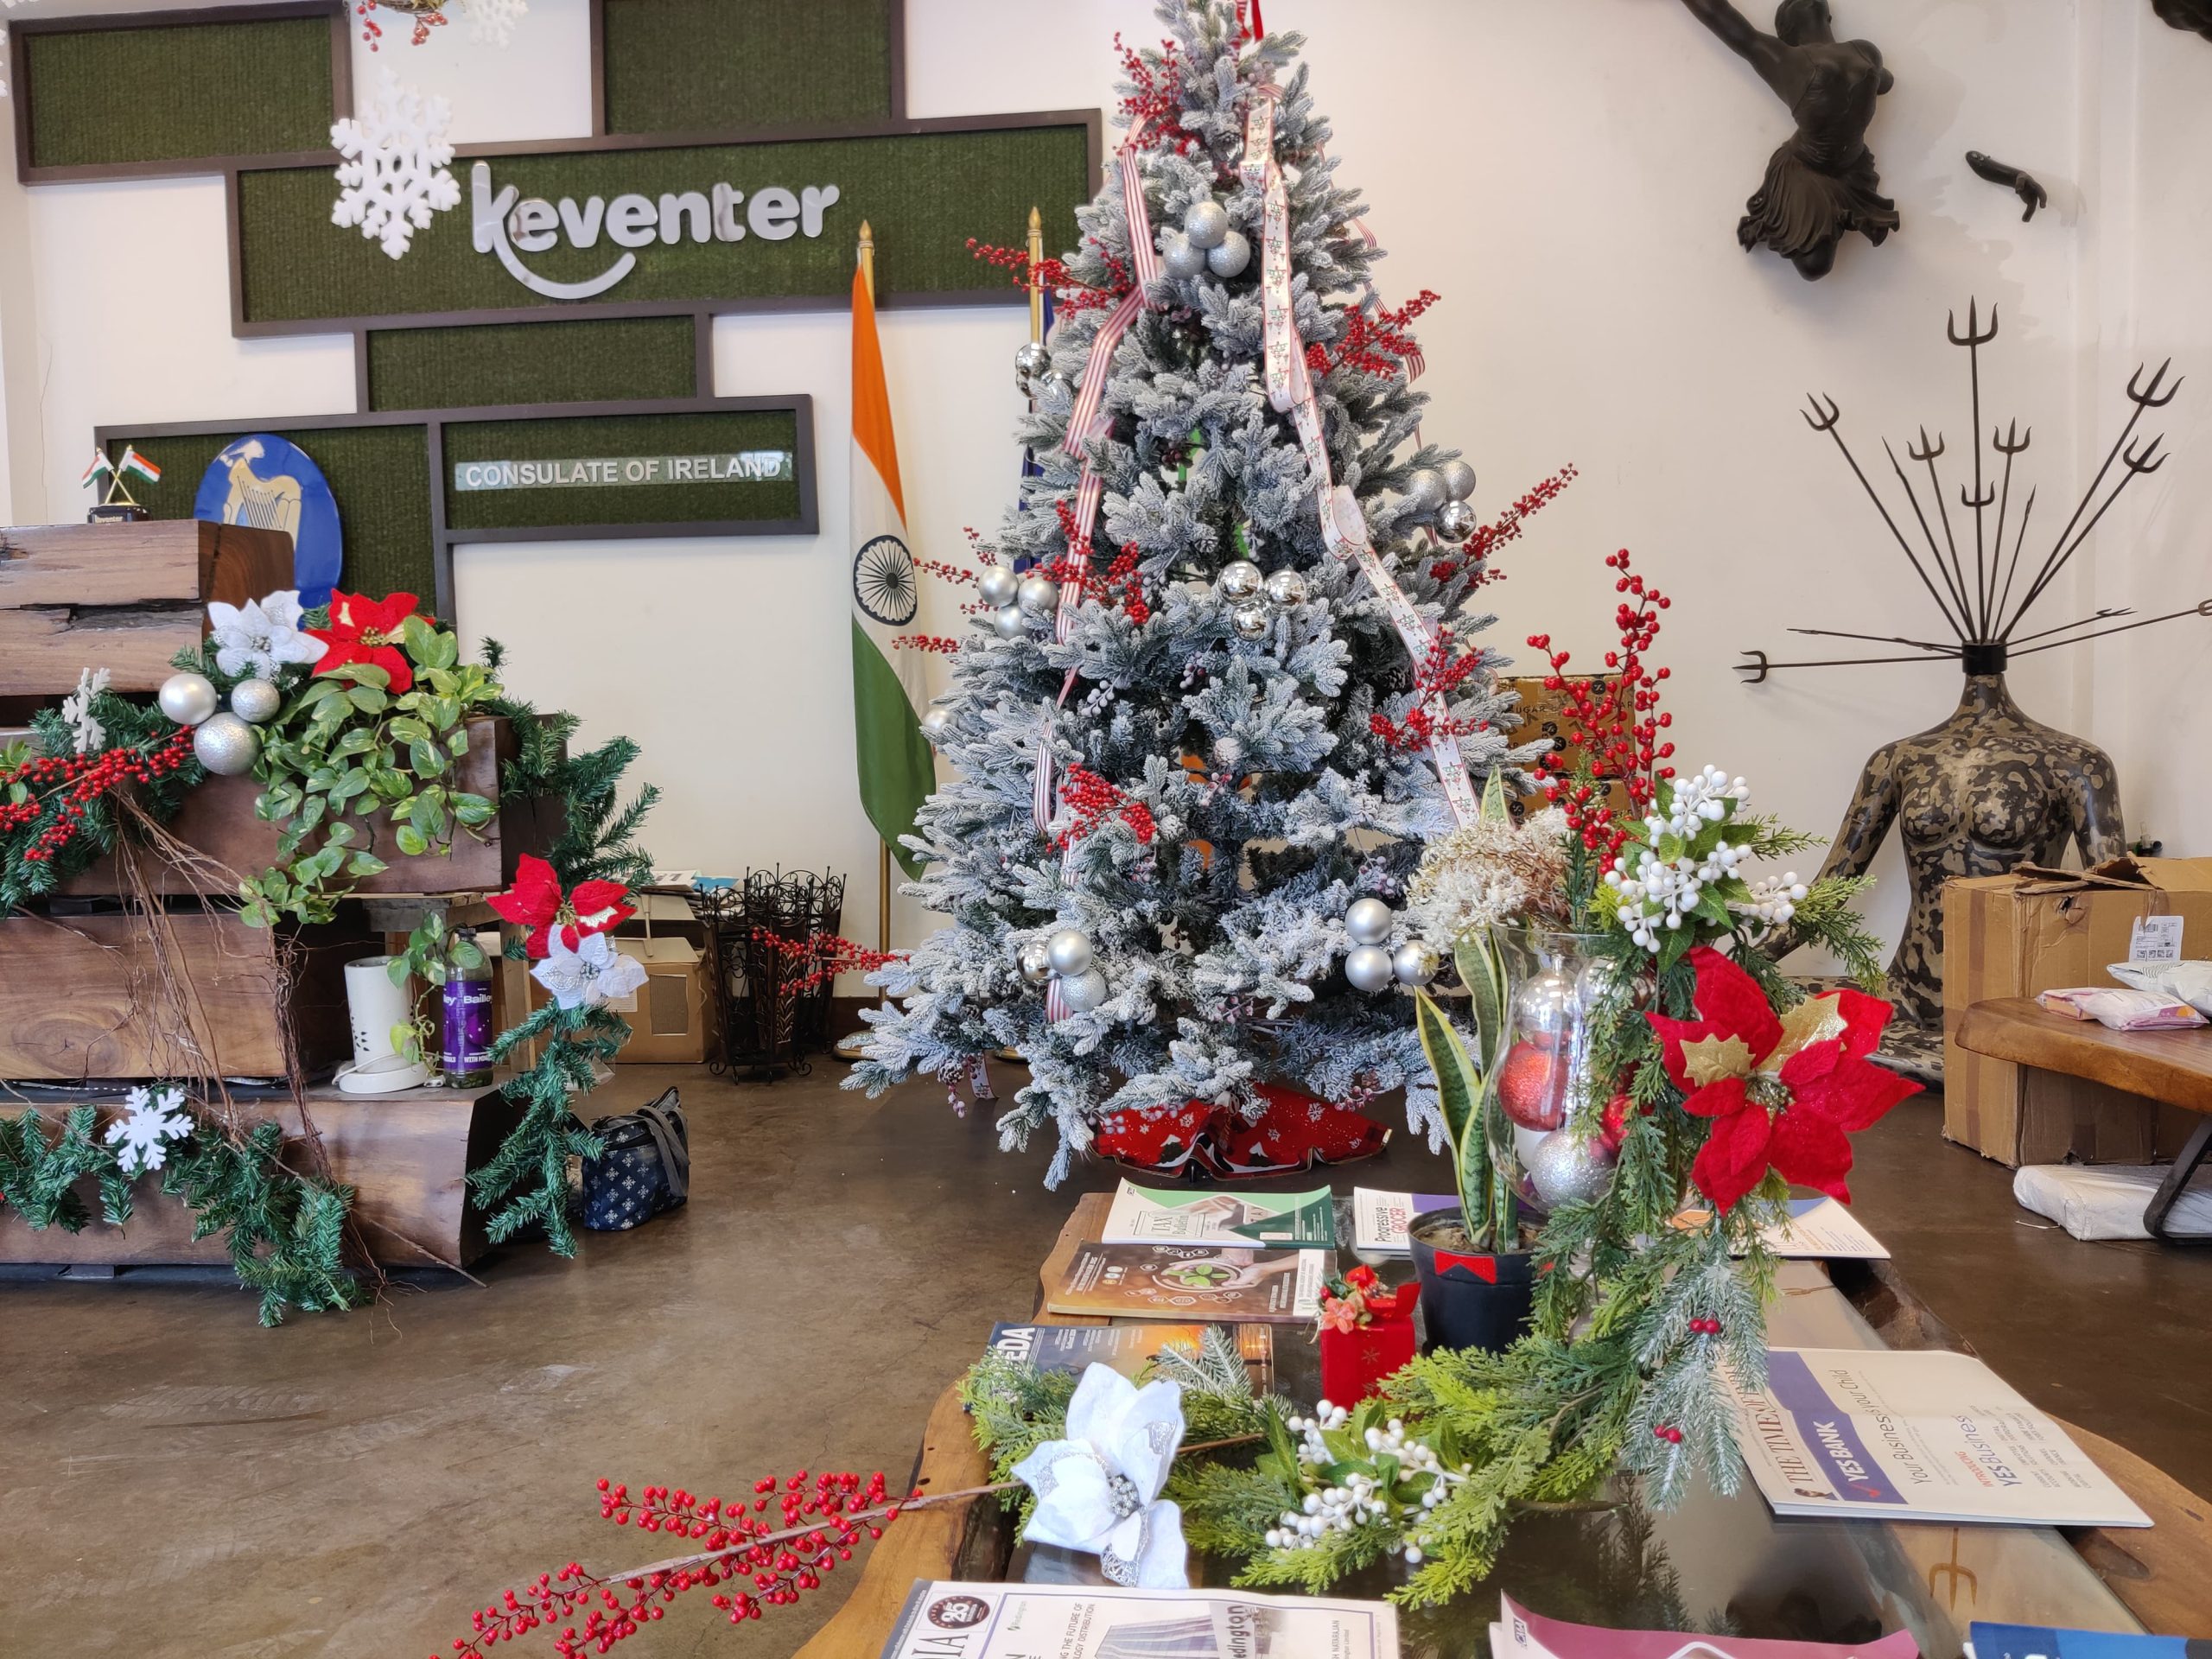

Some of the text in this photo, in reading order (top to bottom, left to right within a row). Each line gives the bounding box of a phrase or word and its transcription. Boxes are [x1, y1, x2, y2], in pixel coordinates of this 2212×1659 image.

[471, 161, 840, 298] keventer
[465, 454, 781, 487] CONSULATE OF IRELAND
[1516, 705, 1545, 714] UGAR
[1375, 1206, 1392, 1243] Progressive
[1389, 1207, 1408, 1234] GROCER
[1828, 1370, 1859, 1389] Child
[1813, 1421, 1870, 1483] YES BANK
[1776, 1455, 1815, 1484] THE
[1904, 1459, 1932, 1484] Your
[941, 1601, 970, 1623] 25
[1067, 1613, 1080, 1637] FUTURE
